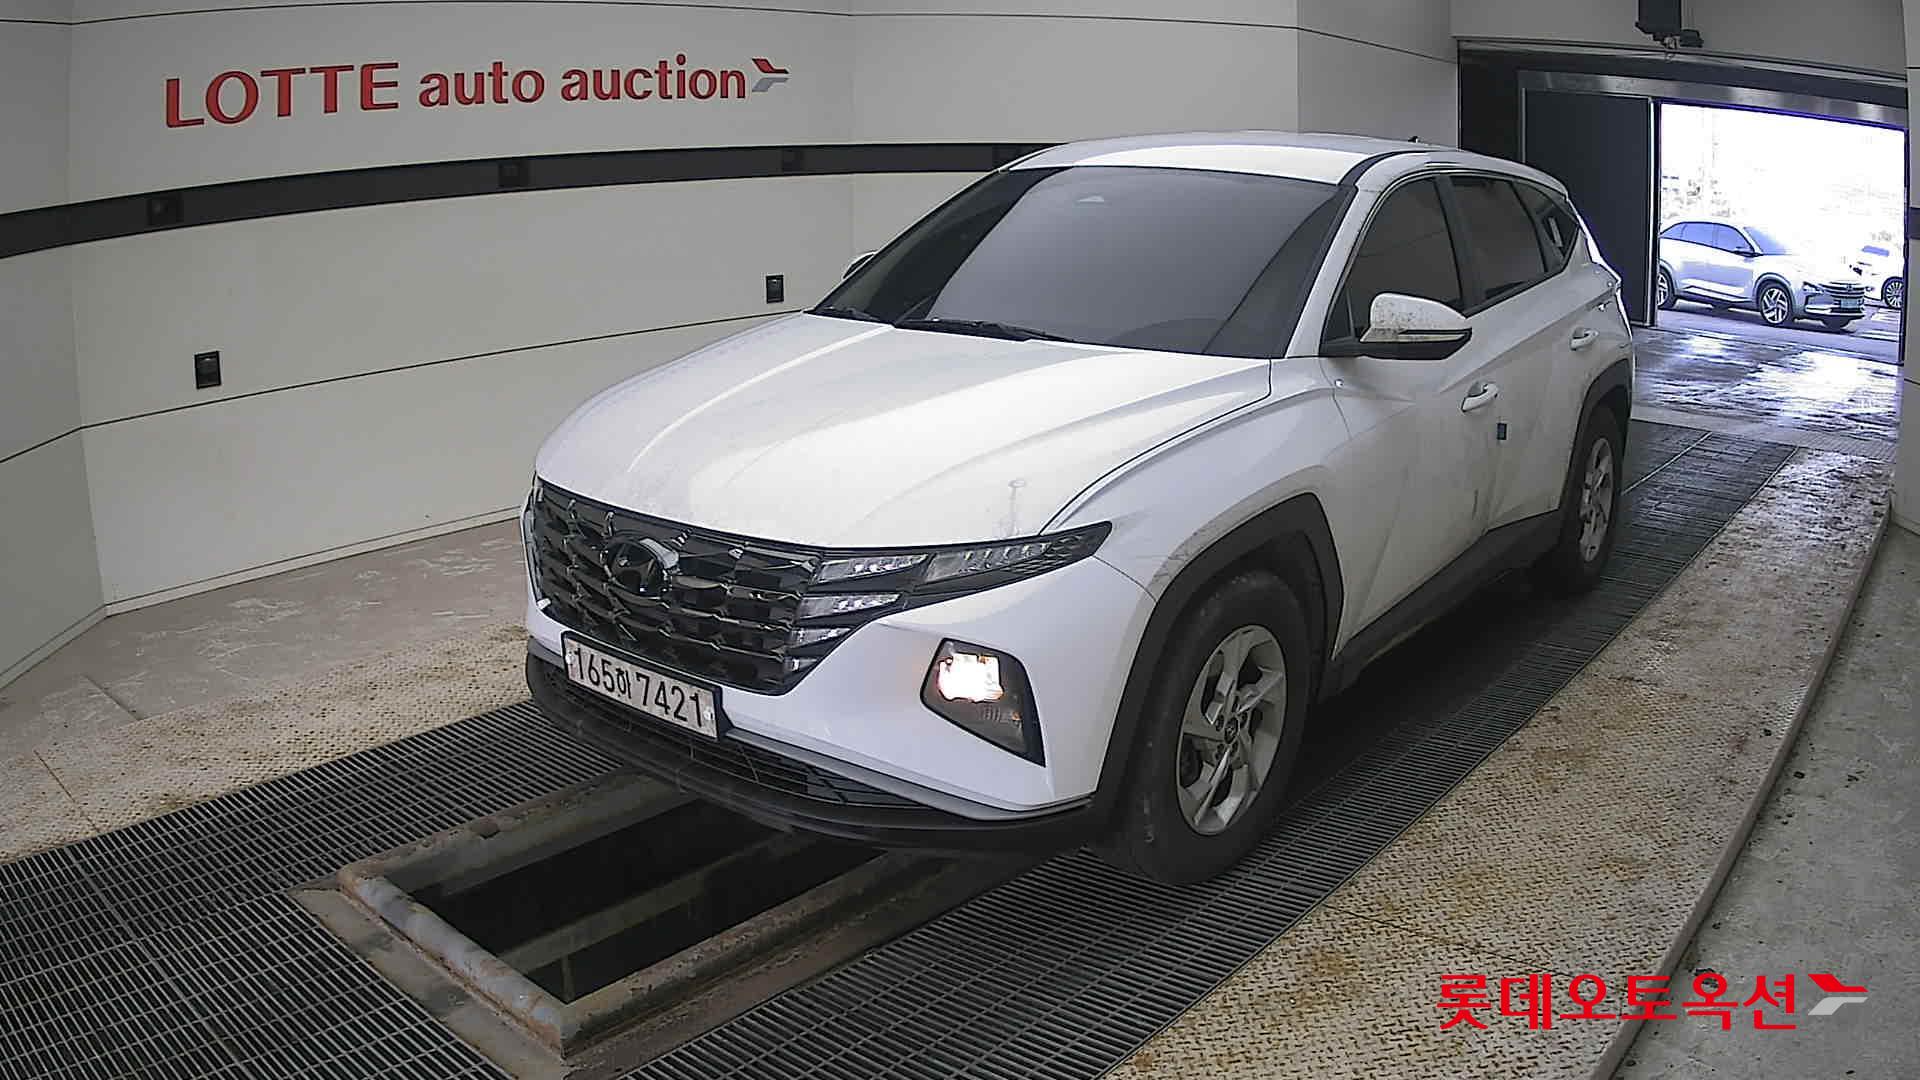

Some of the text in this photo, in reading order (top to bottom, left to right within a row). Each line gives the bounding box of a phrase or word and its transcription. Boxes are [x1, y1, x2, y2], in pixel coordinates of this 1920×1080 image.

[164, 53, 747, 128] LOTTE auto auction
[635, 671, 702, 728] 7421
